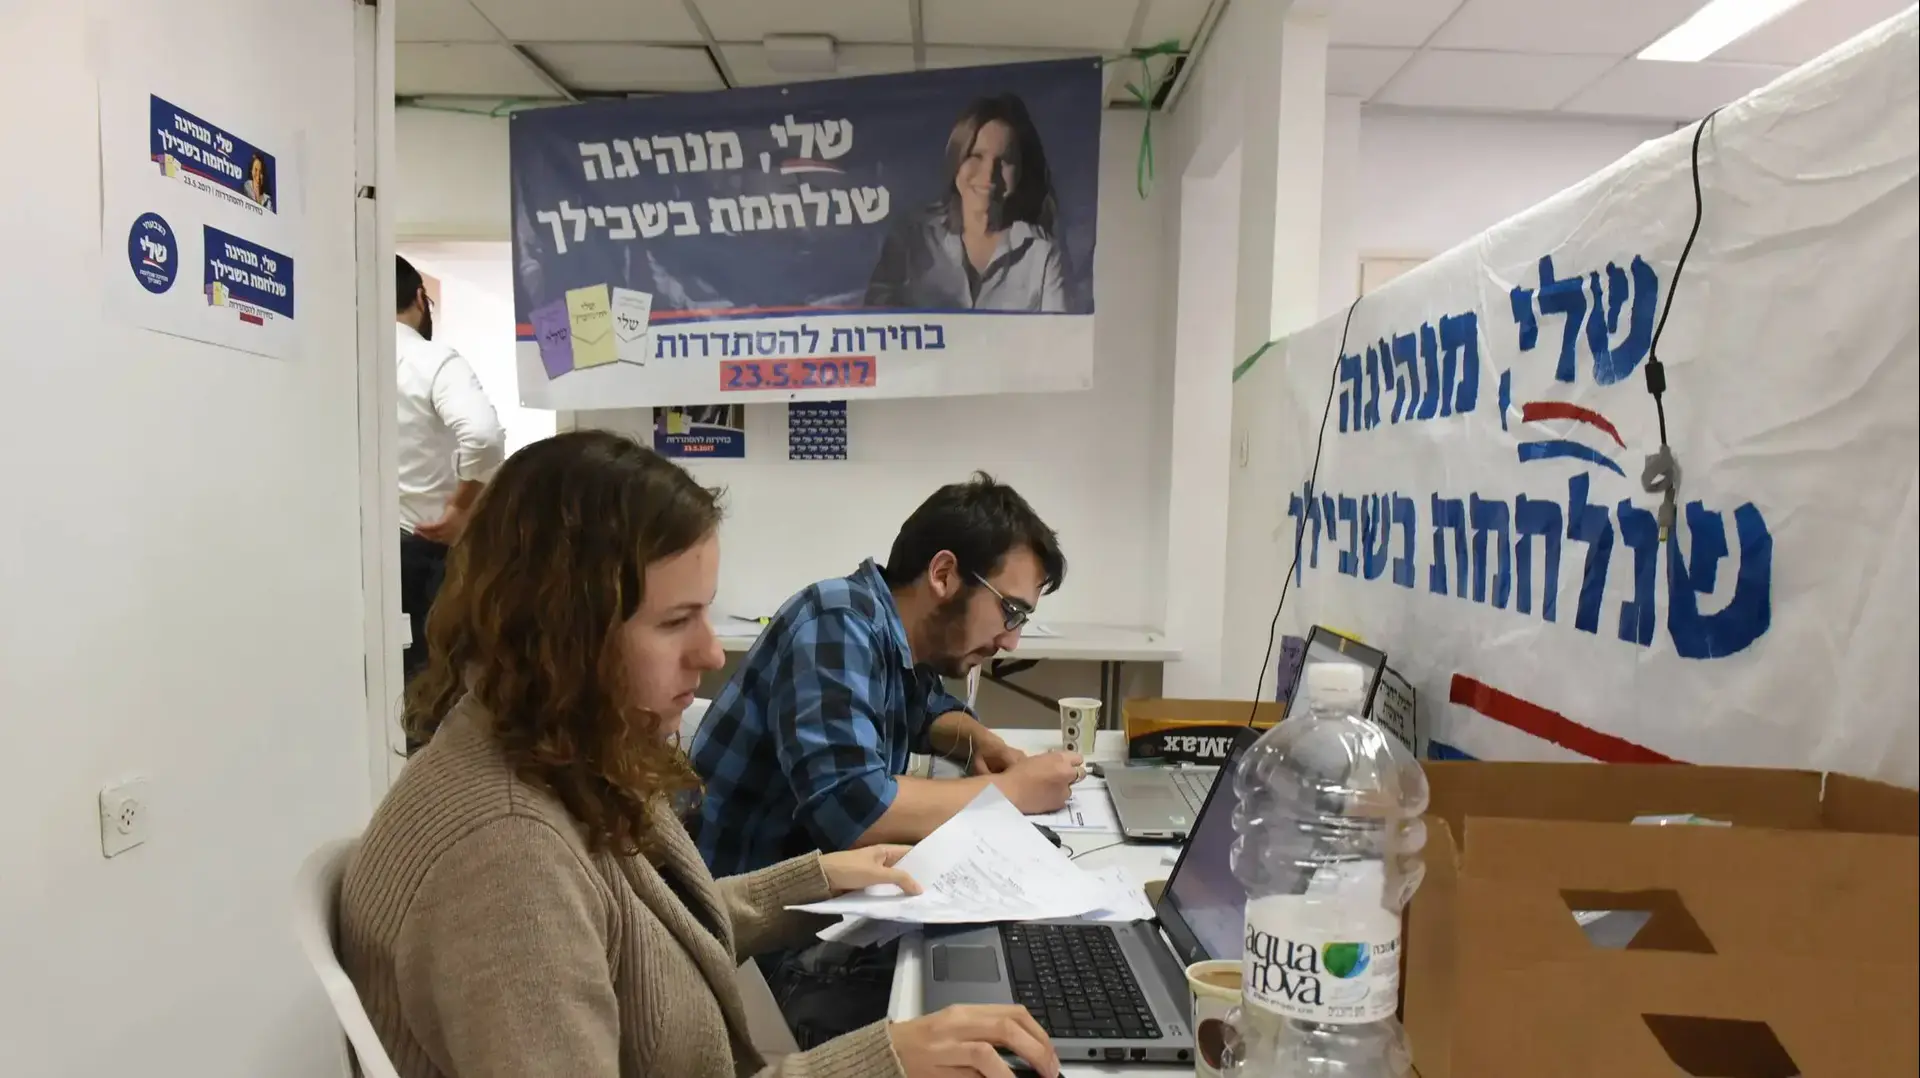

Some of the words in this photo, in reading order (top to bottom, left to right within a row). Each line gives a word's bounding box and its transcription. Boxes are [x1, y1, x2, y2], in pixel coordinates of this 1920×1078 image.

[157, 128, 202, 162] בשבילך
[174, 113, 211, 146] מנהיגה
[760, 114, 854, 174] שלי,
[202, 149, 243, 180] שנלחמת
[578, 130, 744, 181] מנהיגה
[707, 183, 890, 236] שנלחמת
[536, 200, 701, 254] בשבילך
[140, 235, 167, 263] שלי
[224, 242, 258, 268] מנהיגה
[210, 258, 250, 286] בשבילך
[250, 273, 287, 297] שנלחמת
[617, 312, 640, 331] שלי
[830, 324, 946, 352] בחירות
[655, 323, 820, 359] להסתדרות
[727, 361, 870, 388] 23.5.2017
[1339, 310, 1480, 433] מנהיגה
[1287, 480, 1417, 588] בשבילך
[1429, 471, 1774, 659] שנלחמת
[1163, 734, 1233, 758] Max
[1245, 923, 1320, 974] aqua
[1252, 961, 1324, 1006] nova
